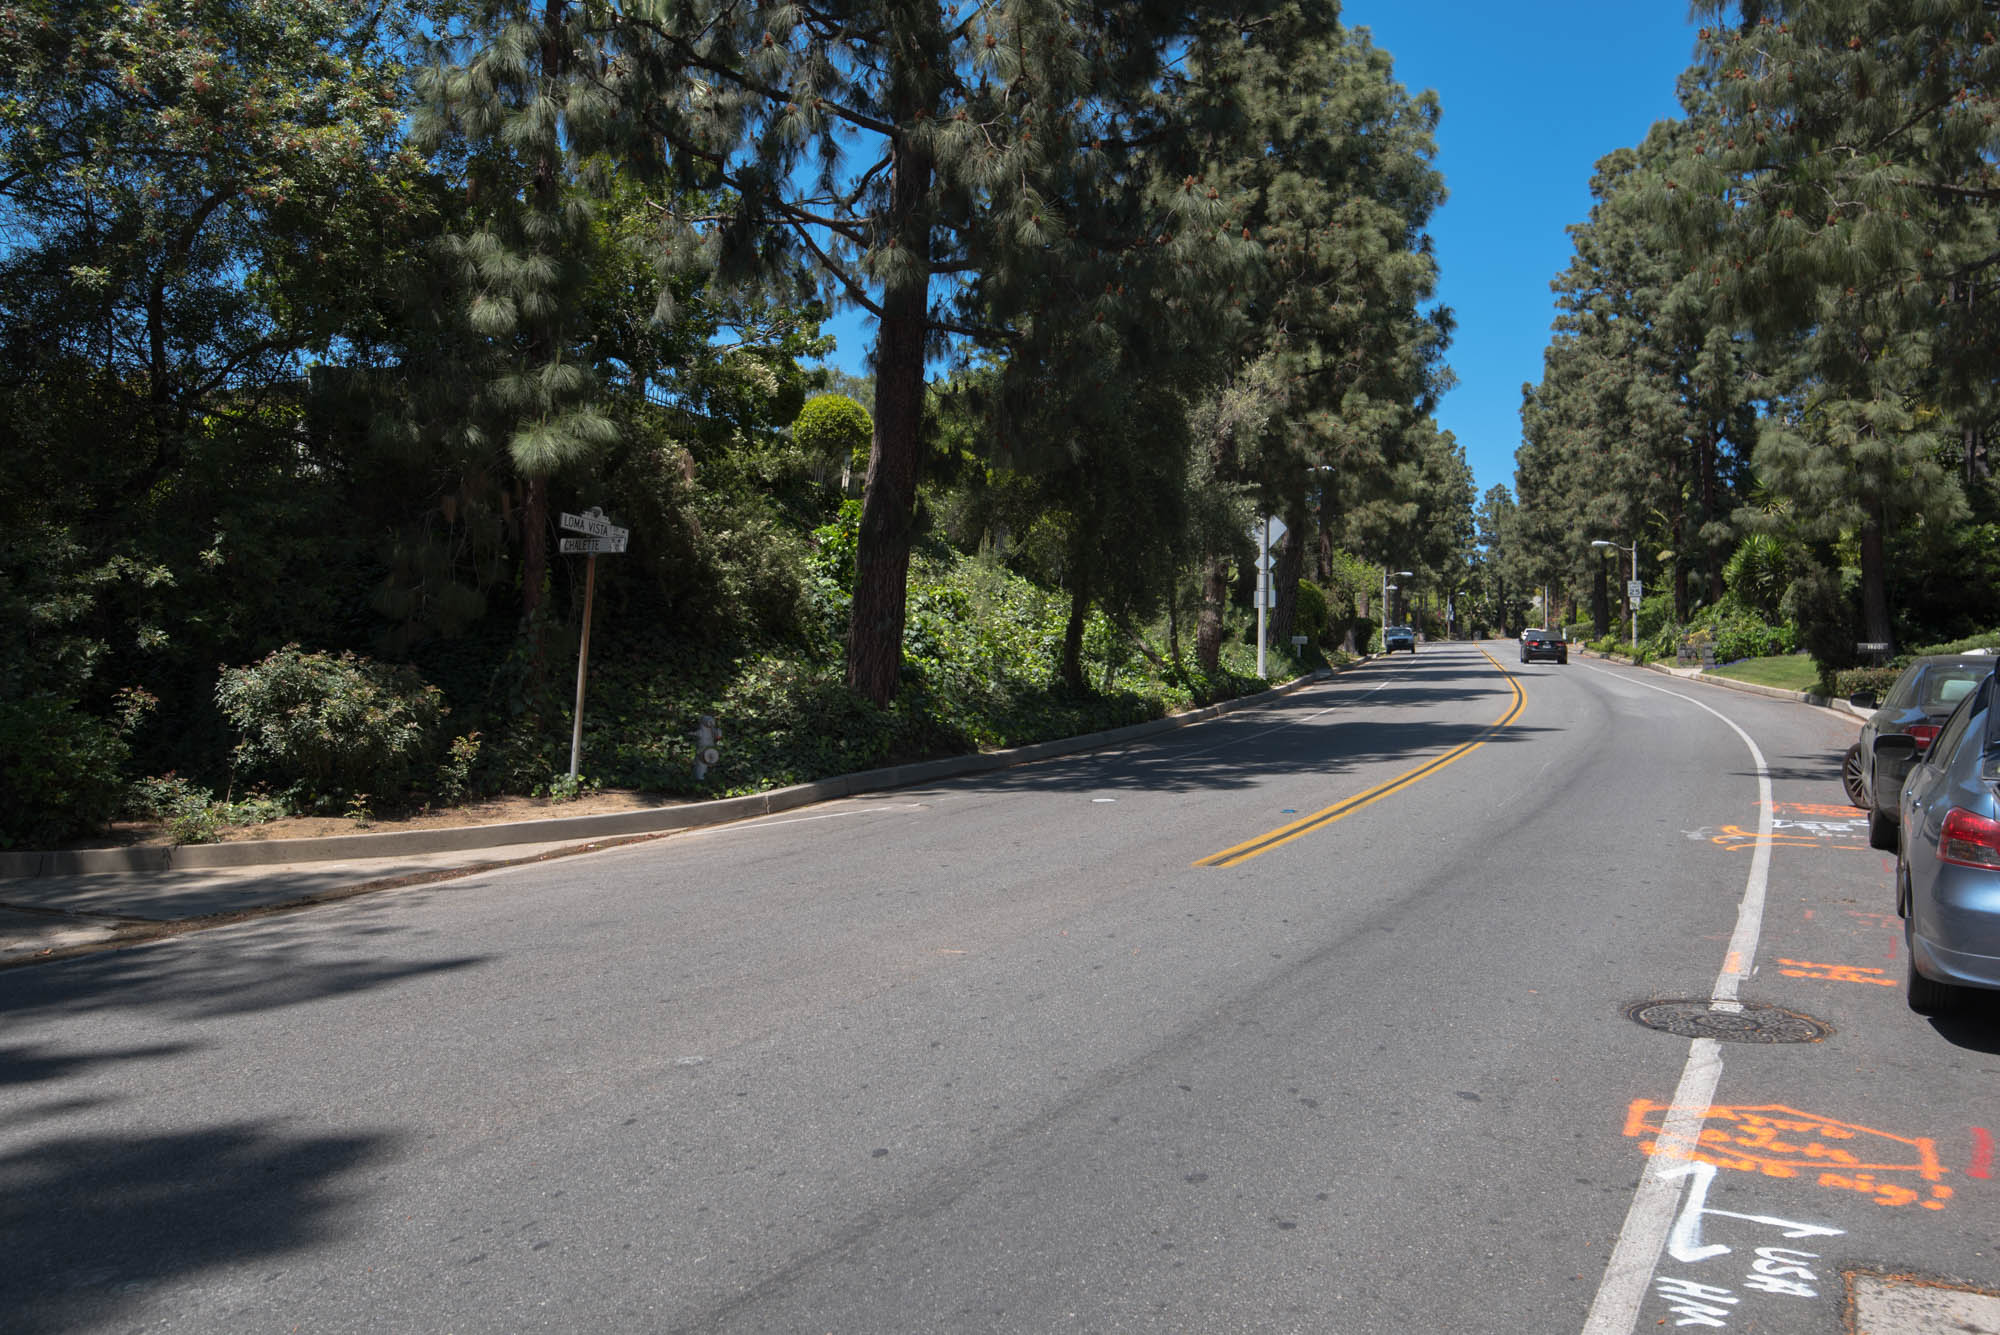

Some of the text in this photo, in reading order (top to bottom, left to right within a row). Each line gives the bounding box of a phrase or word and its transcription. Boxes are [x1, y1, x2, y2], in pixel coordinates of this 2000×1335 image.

[564, 516, 585, 531] LOMA
[588, 520, 608, 537] VISTA
[564, 539, 600, 551] CHALETTE
